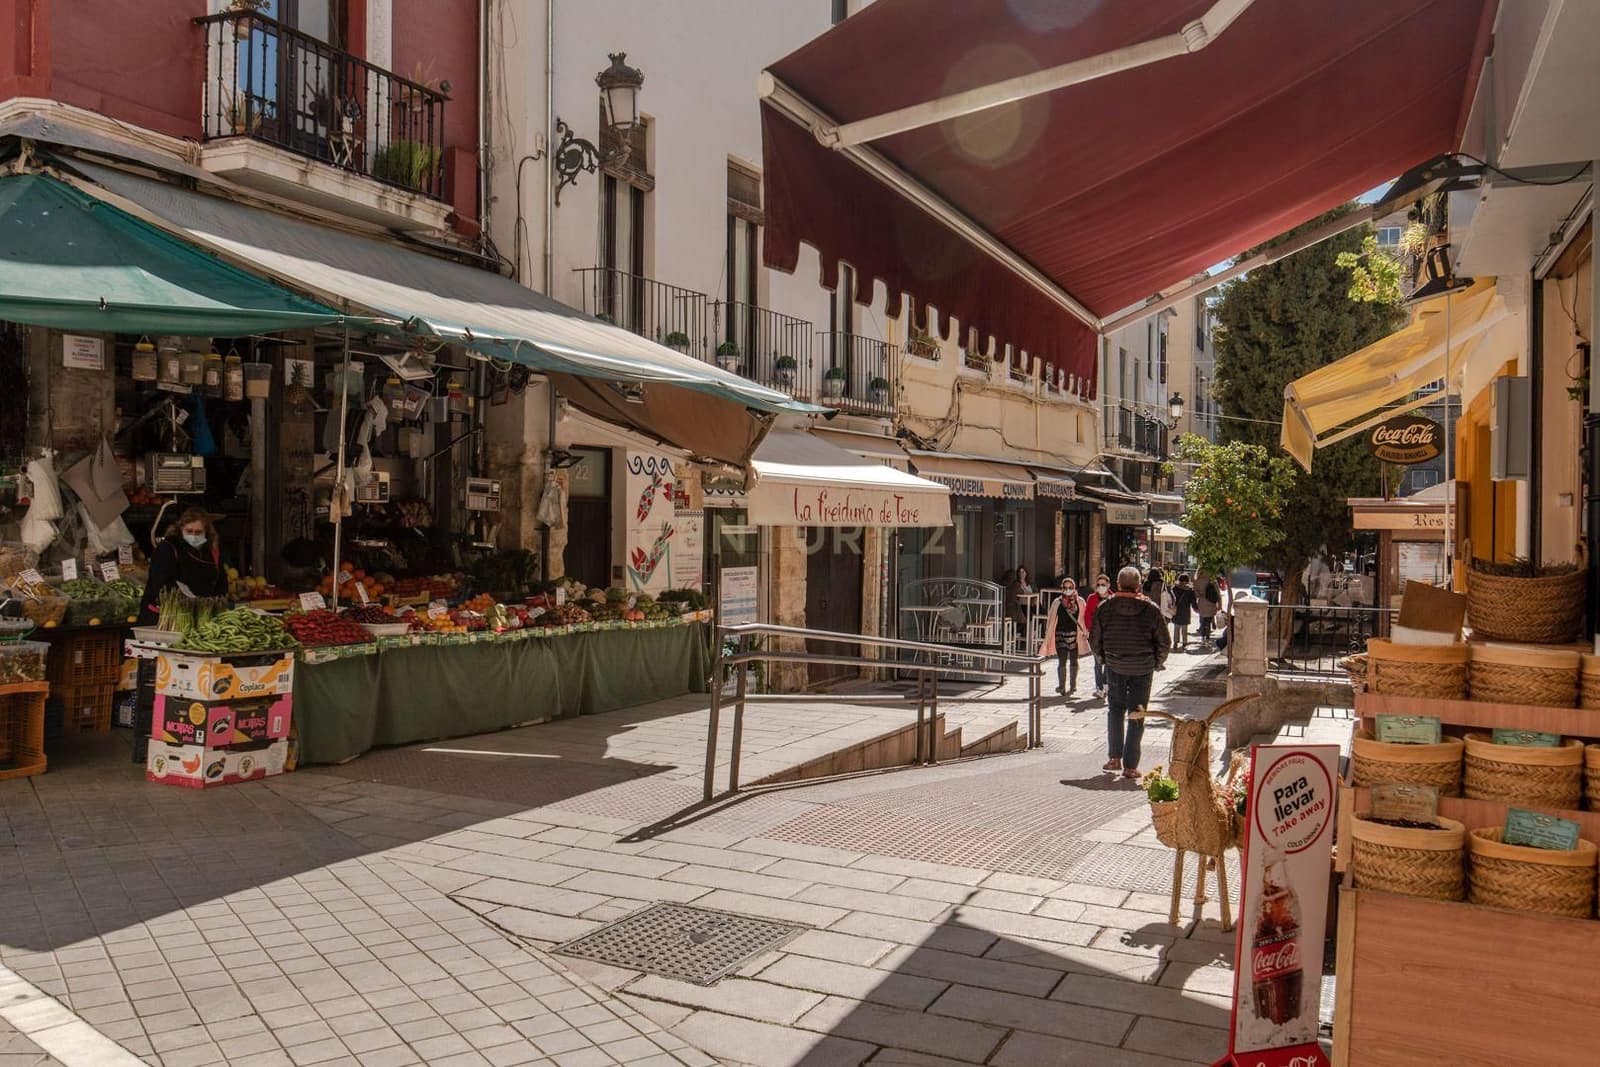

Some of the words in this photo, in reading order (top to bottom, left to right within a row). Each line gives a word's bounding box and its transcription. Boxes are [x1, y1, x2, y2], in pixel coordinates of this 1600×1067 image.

[1372, 424, 1435, 445] Coca-Cola
[575, 464, 592, 480] 22
[1002, 482, 1027, 496] CUNINI
[1038, 481, 1074, 498] RESTAURANTE
[794, 487, 812, 522] La
[879, 499, 893, 524] de
[893, 493, 920, 524] Tere
[1273, 776, 1308, 804] Para
[1274, 788, 1315, 823] llevar
[1272, 817, 1298, 837] Take
[1300, 798, 1326, 821] away
[1287, 839, 1303, 848] COLD
